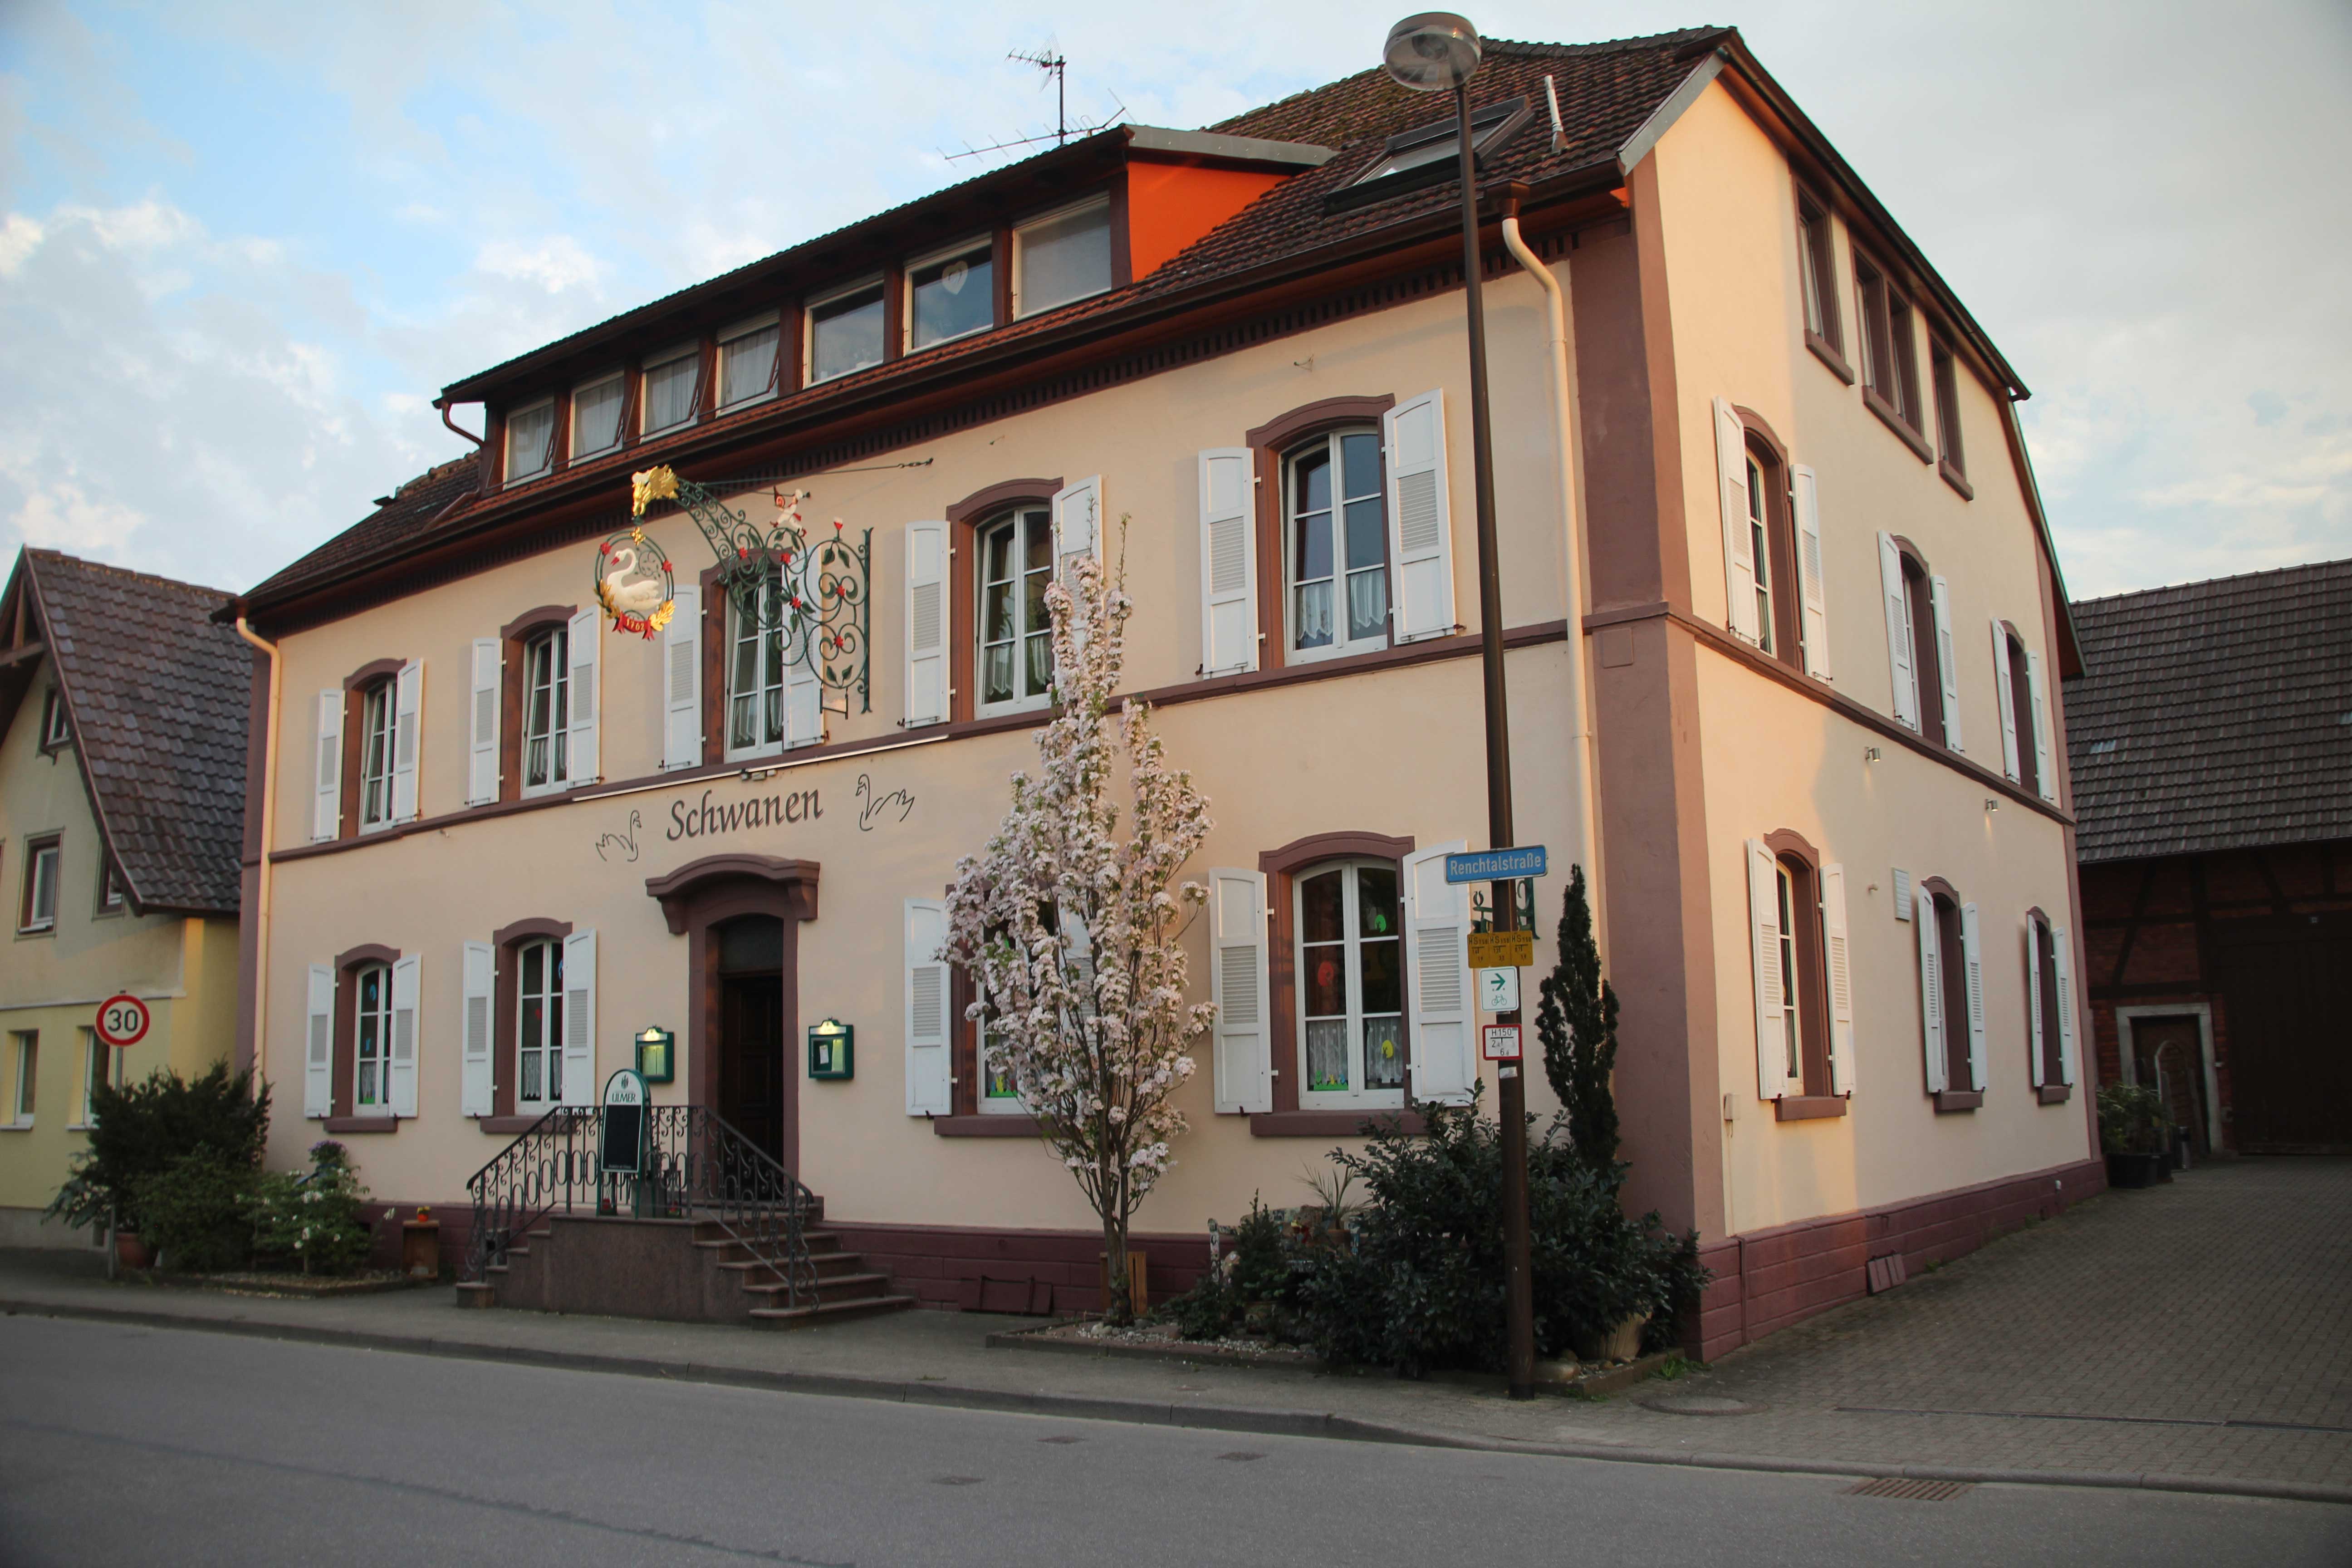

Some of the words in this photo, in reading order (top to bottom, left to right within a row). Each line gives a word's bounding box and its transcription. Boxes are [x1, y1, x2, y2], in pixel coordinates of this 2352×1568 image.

[627, 618, 644, 631] 1762
[667, 789, 823, 841] Schwanen
[1450, 853, 1541, 875] Renchtalstraße
[108, 1009, 138, 1032] 30
[612, 1093, 636, 1102] ULMER
